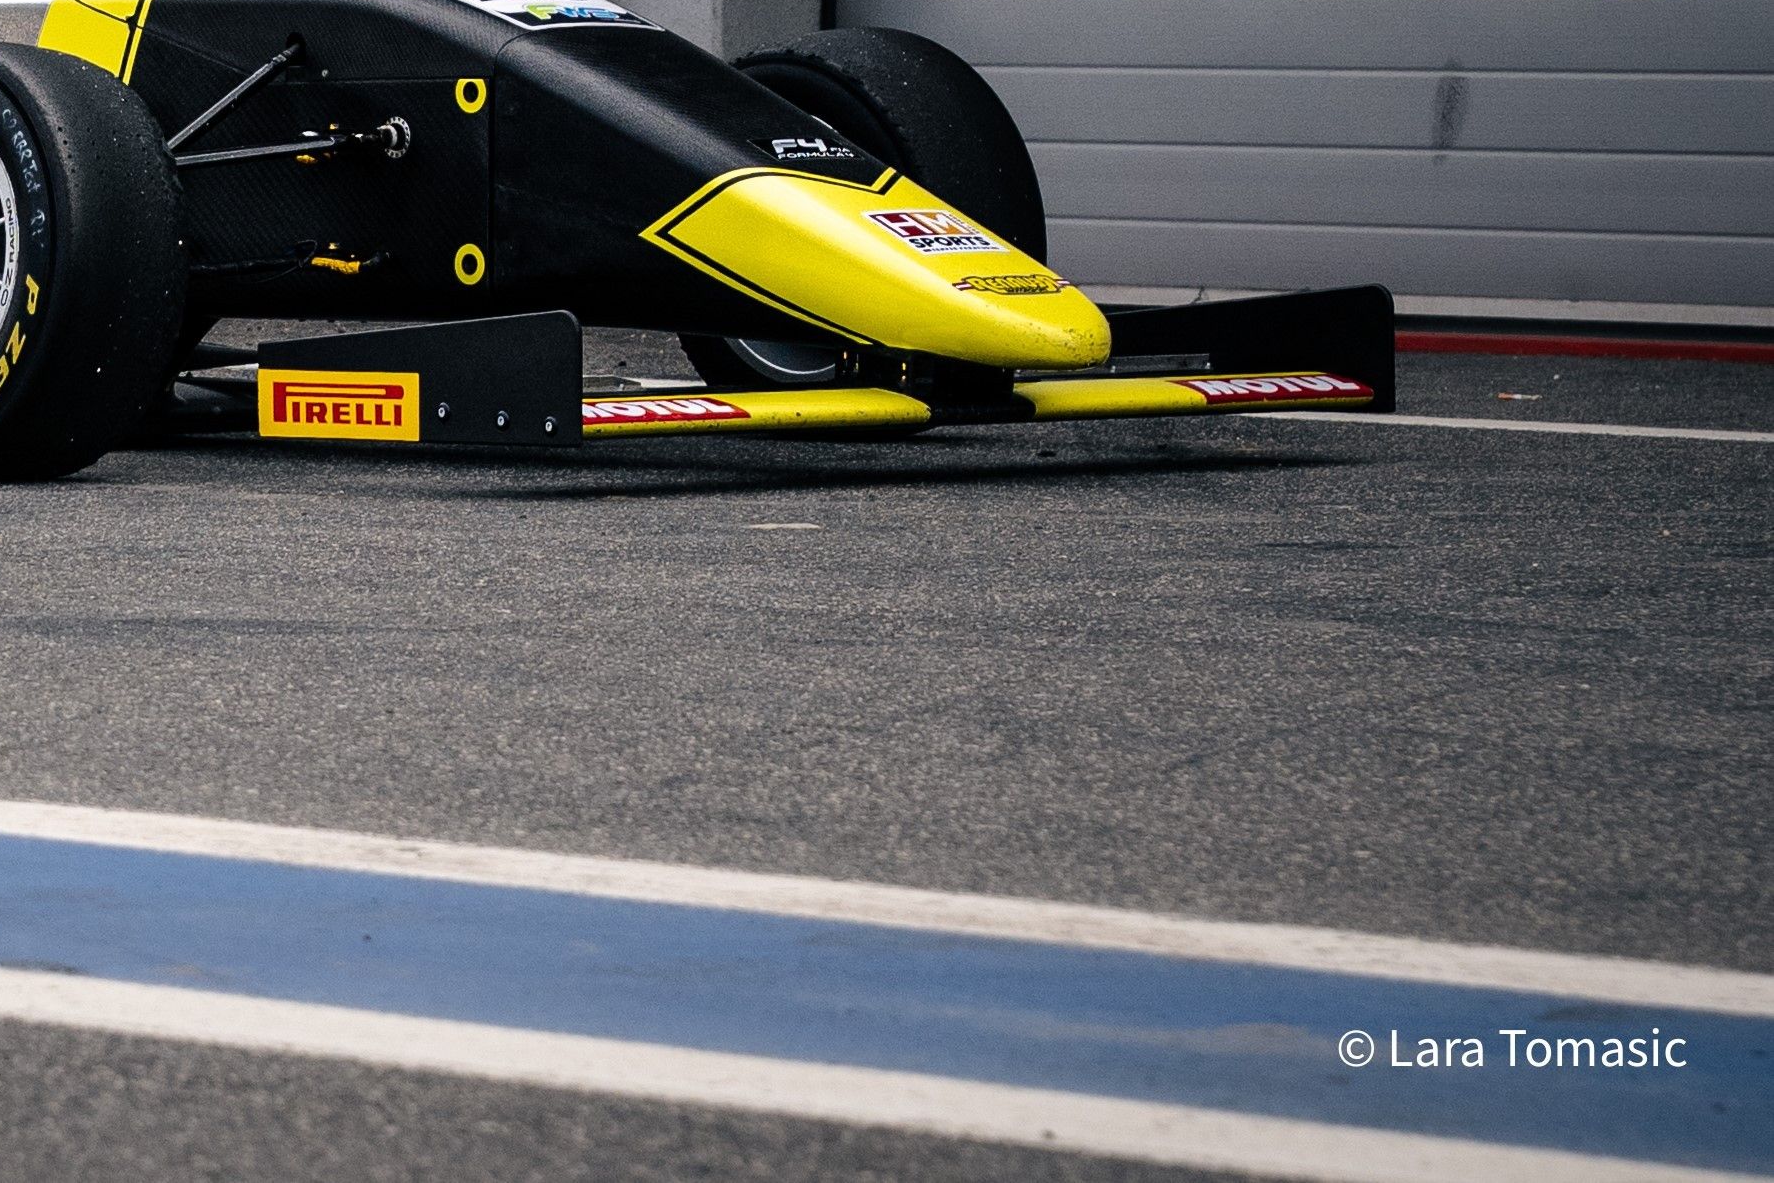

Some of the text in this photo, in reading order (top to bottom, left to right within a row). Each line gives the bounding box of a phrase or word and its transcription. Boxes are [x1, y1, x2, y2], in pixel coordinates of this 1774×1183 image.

[771, 138, 828, 154] F4
[871, 212, 975, 237] HM
[908, 236, 991, 248] SPORTS
[26, 273, 39, 315] P
[1188, 375, 1361, 396] MOTUL
[272, 381, 405, 426] PIRELLI
